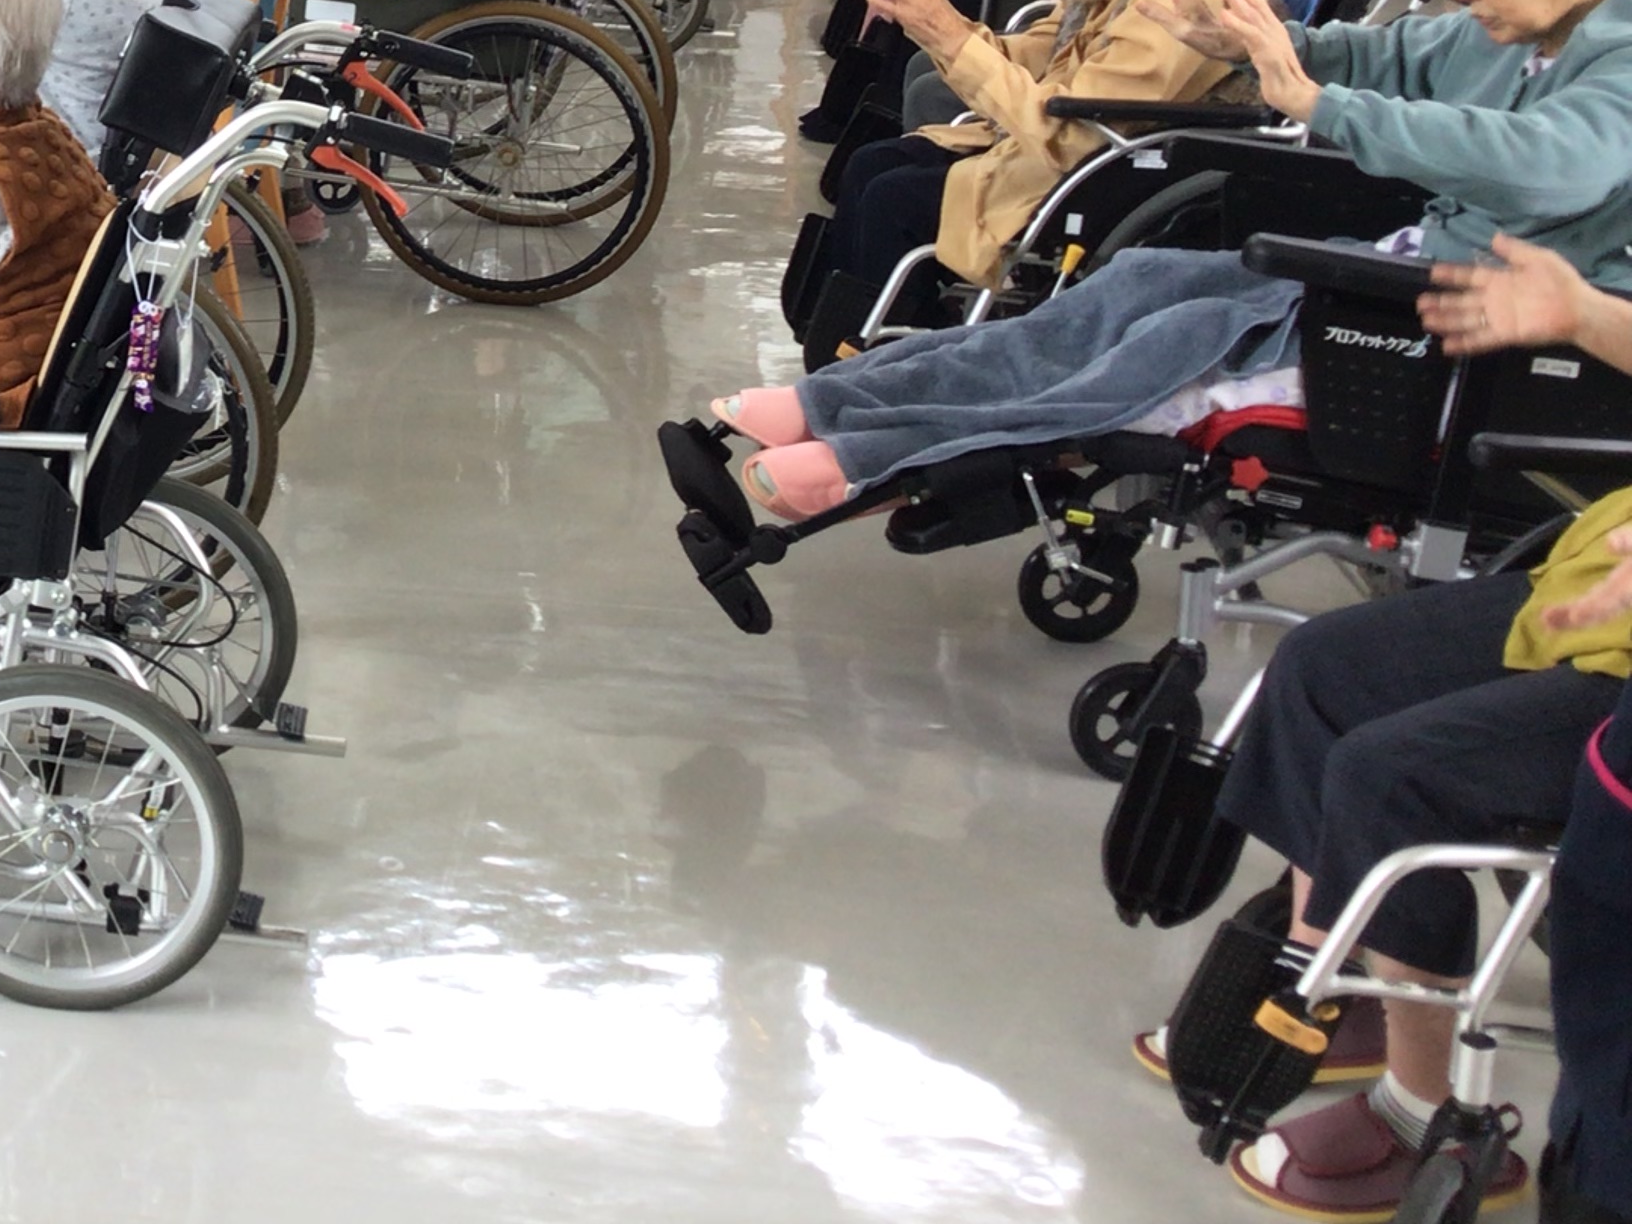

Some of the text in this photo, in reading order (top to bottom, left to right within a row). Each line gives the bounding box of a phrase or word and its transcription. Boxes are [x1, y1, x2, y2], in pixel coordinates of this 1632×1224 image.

[1324, 326, 1412, 352] プロフィットケア
